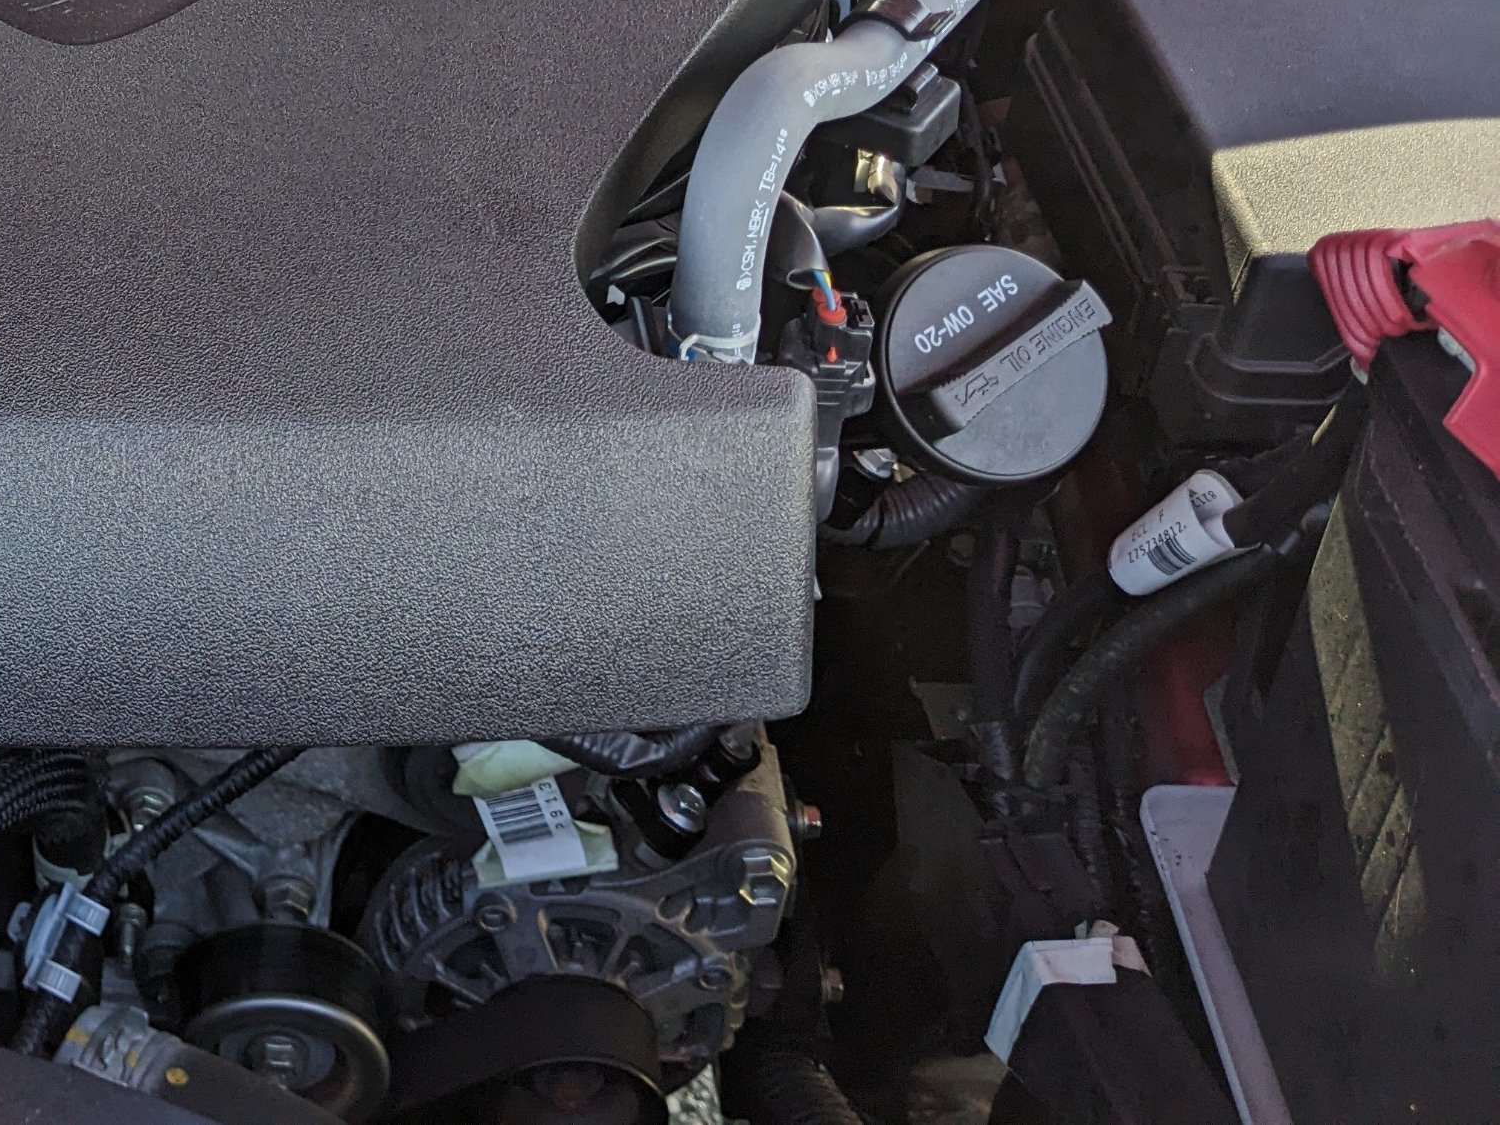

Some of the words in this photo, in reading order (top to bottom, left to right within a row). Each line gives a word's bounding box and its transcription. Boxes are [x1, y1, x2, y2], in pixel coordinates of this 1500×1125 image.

[977, 274, 1018, 312] SAE
[914, 305, 974, 354] 0W-20
[1029, 298, 1096, 356] ENGINE
[1000, 345, 1032, 372] OIL
